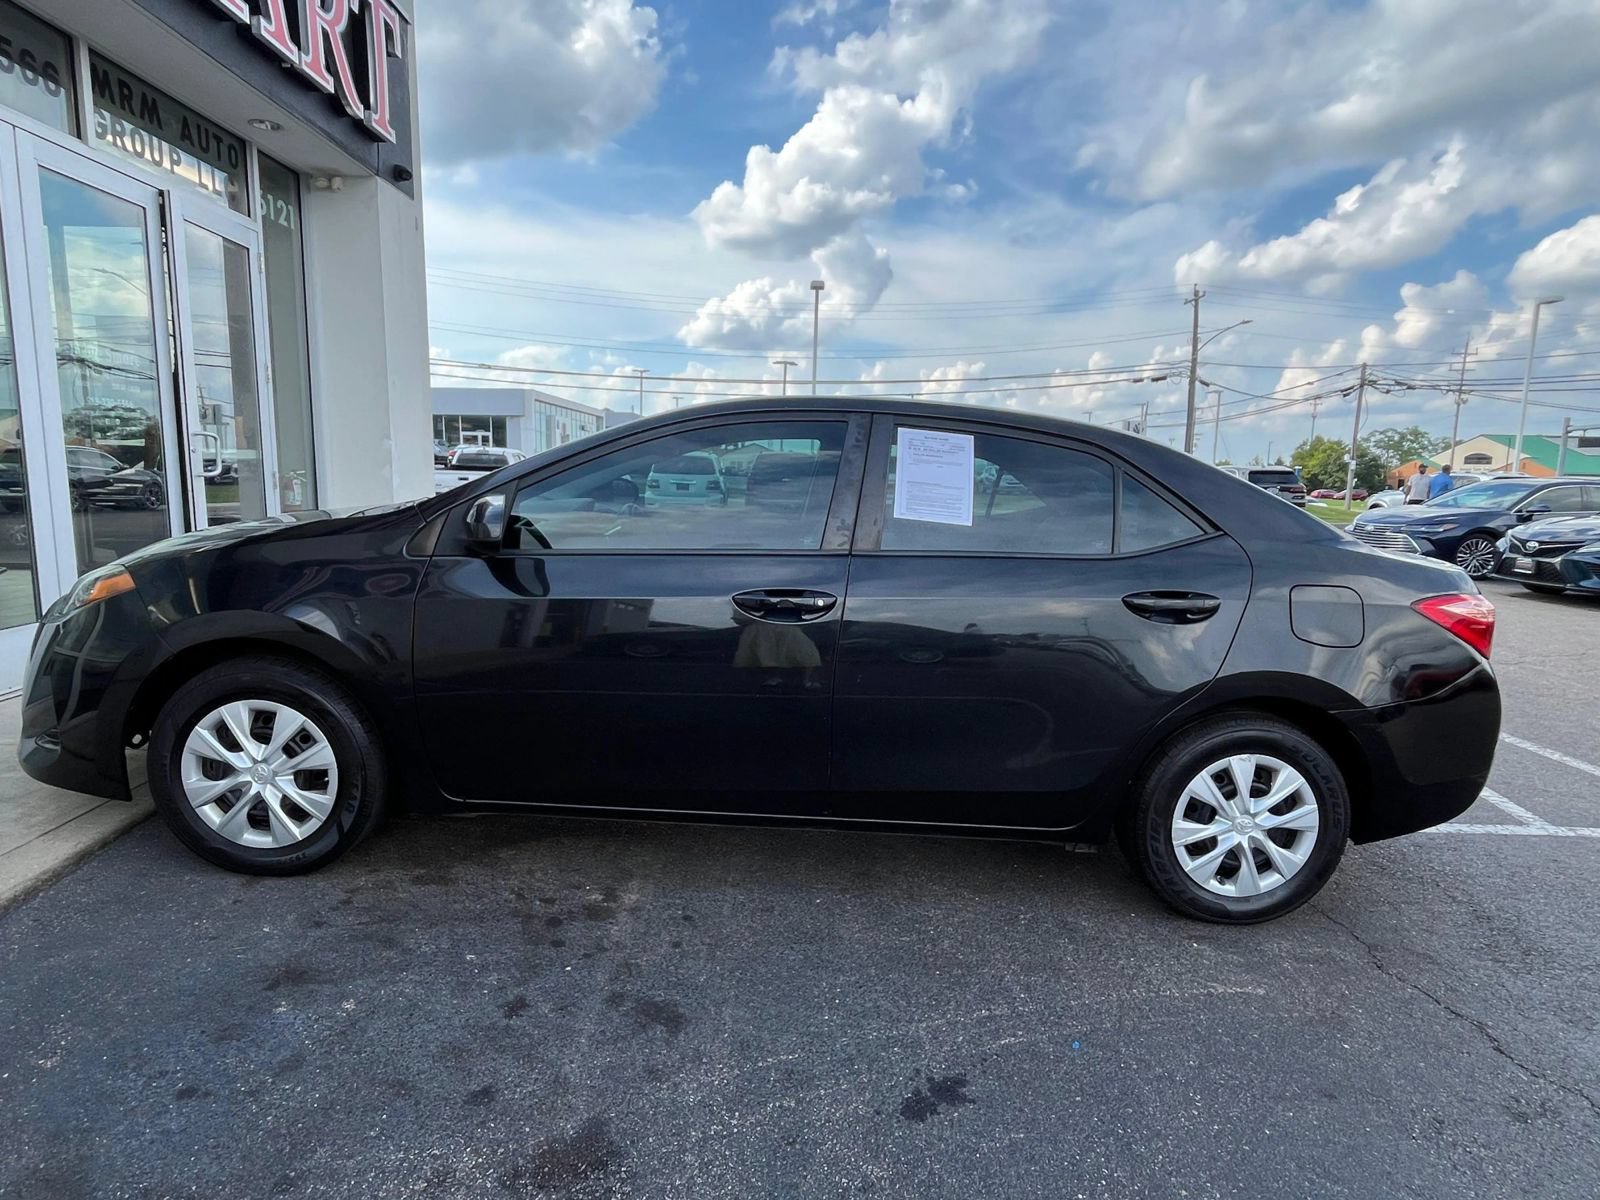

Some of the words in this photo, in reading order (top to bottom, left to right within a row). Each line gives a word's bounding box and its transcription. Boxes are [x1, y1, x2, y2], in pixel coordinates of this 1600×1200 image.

[90, 62, 163, 130] MRM
[180, 115, 239, 170] AUTO
[94, 108, 182, 174] GROUP
